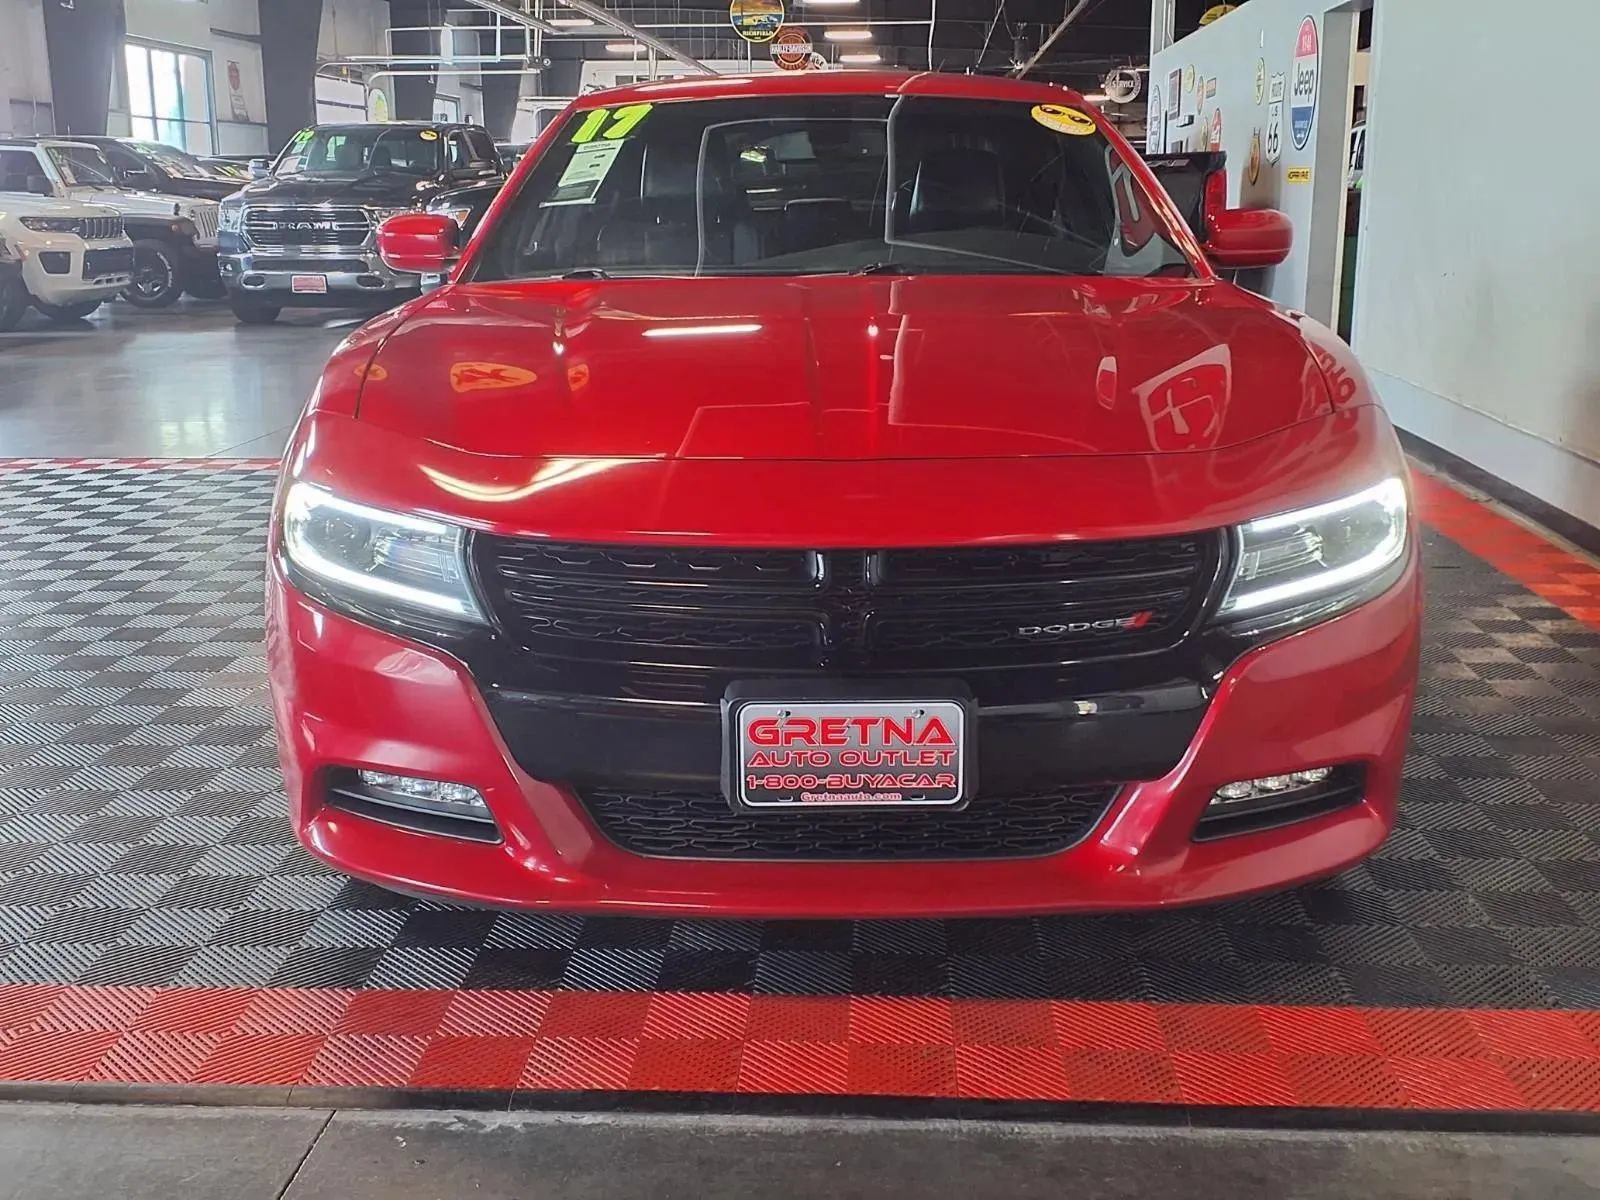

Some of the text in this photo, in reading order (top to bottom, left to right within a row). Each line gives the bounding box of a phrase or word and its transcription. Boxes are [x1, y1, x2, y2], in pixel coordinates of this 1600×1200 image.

[1294, 63, 1315, 104] Jeep
[571, 102, 654, 143] 17
[1267, 122, 1280, 154] 66
[279, 221, 331, 230] RAM
[1017, 616, 1137, 635] DODGE
[747, 716, 956, 747] GRETNA
[746, 749, 957, 768] AUTO OUTLET
[746, 773, 956, 790] 1-800-BUYACAR
[800, 791, 902, 803] Gretnaauto.com
